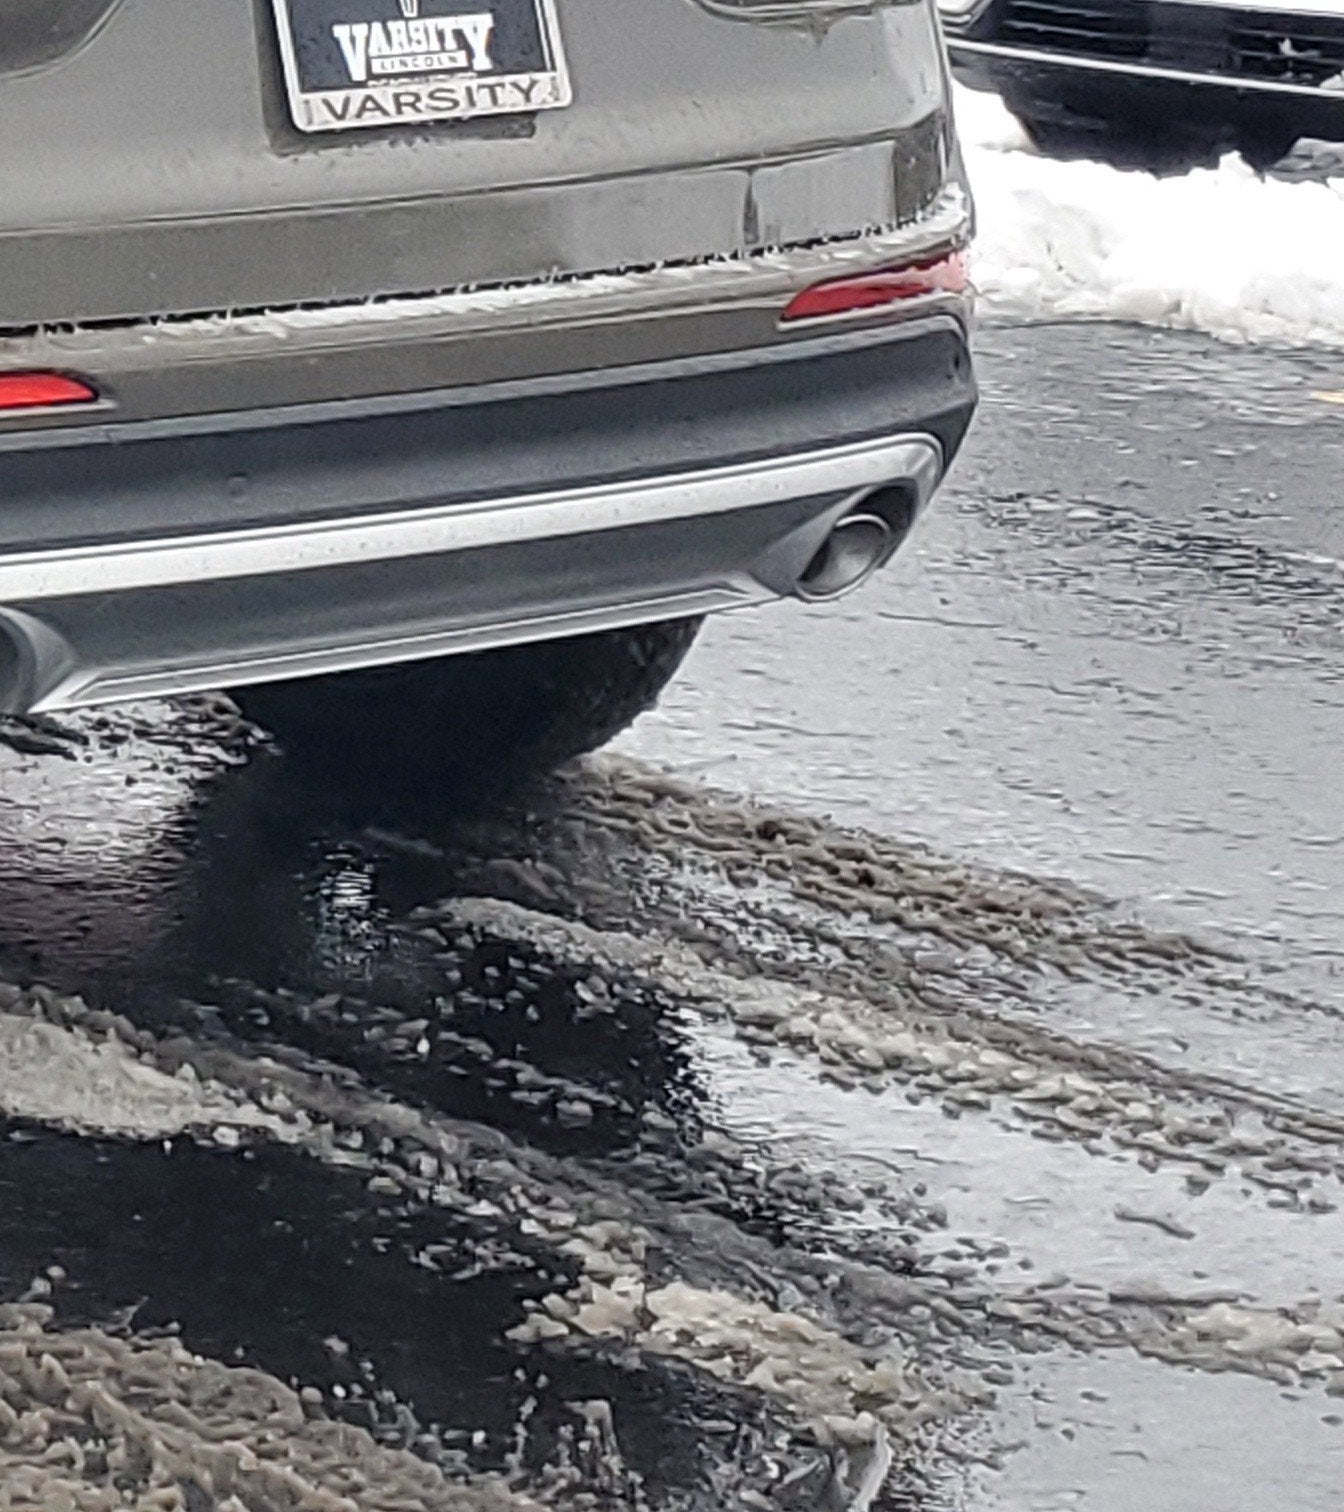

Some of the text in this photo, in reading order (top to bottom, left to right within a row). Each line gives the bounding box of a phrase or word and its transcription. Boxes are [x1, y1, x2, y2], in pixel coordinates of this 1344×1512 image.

[332, 13, 495, 83] VARSITY
[380, 55, 459, 71] LINCOLN
[322, 78, 539, 122] VARSITY
